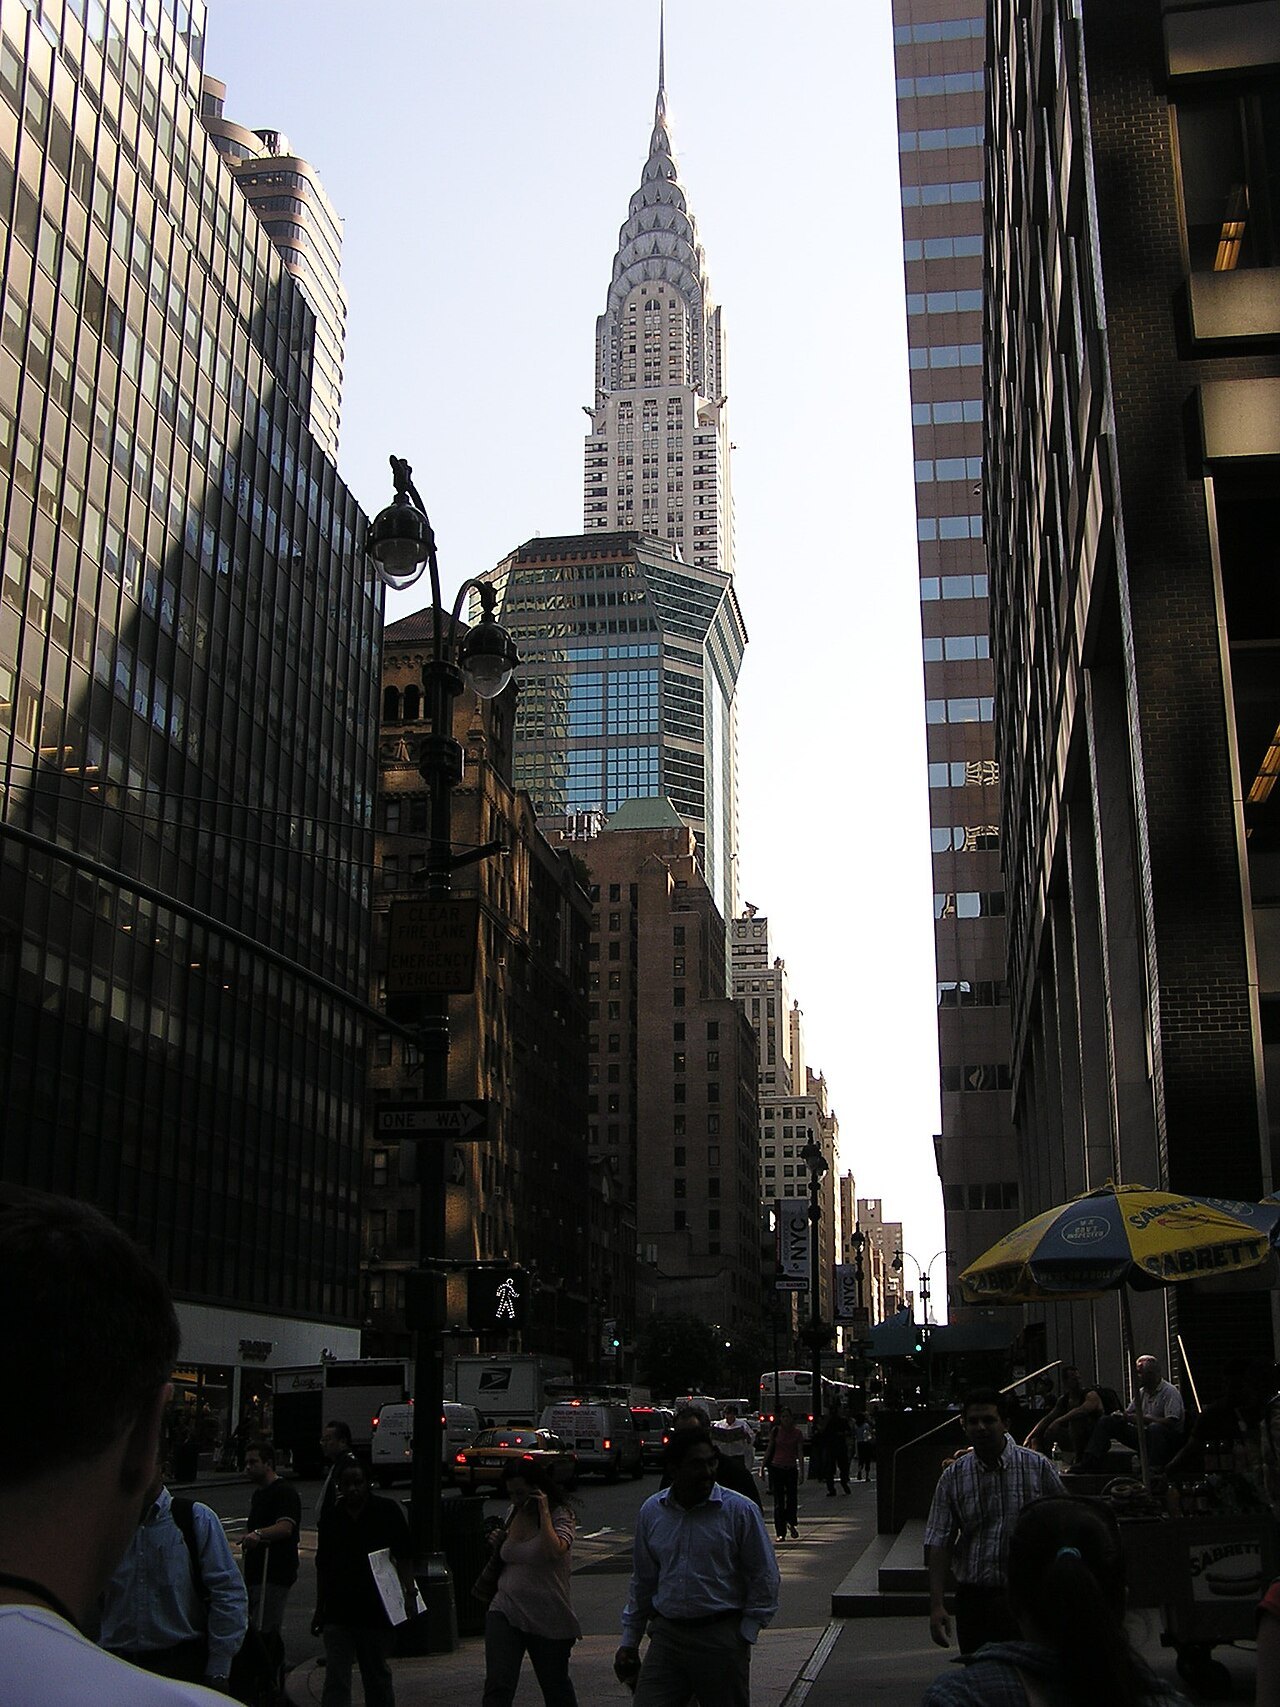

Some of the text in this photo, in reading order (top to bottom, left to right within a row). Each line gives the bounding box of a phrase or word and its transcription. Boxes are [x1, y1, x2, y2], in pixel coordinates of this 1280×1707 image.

[408, 907, 460, 922] CLEAR
[399, 924, 466, 939] FIRE LANE
[423, 940, 441, 952] FOR
[391, 952, 468, 969] EMERGENCY
[398, 971, 463, 986] VEHICLES
[383, 1112, 470, 1128] ONE WAY
[790, 1218, 806, 1260] NYC
[1144, 1237, 1260, 1277] SABRETT
[843, 1277, 855, 1306] NYC
[1189, 1544, 1260, 1577] SABRETT
